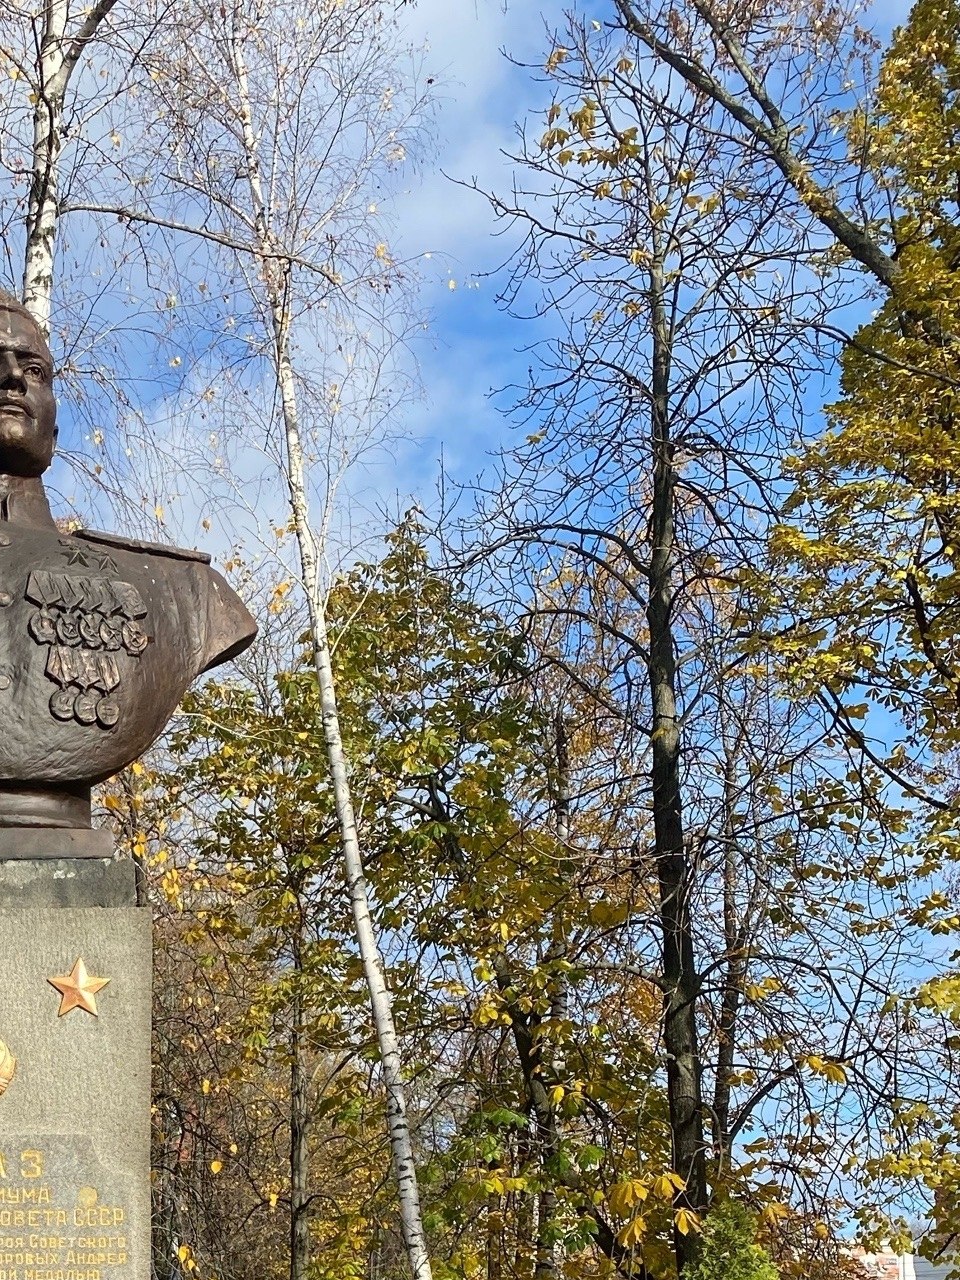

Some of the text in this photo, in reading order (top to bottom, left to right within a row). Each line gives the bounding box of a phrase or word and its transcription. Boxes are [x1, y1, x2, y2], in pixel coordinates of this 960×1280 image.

[73, 1208, 124, 1225] СССР
[29, 1234, 126, 1248] СОВЕТСКОГО
[66, 1251, 127, 1265] АНДРЕЯ
[24, 1269, 100, 1280] МЕДАЛЬЮ
